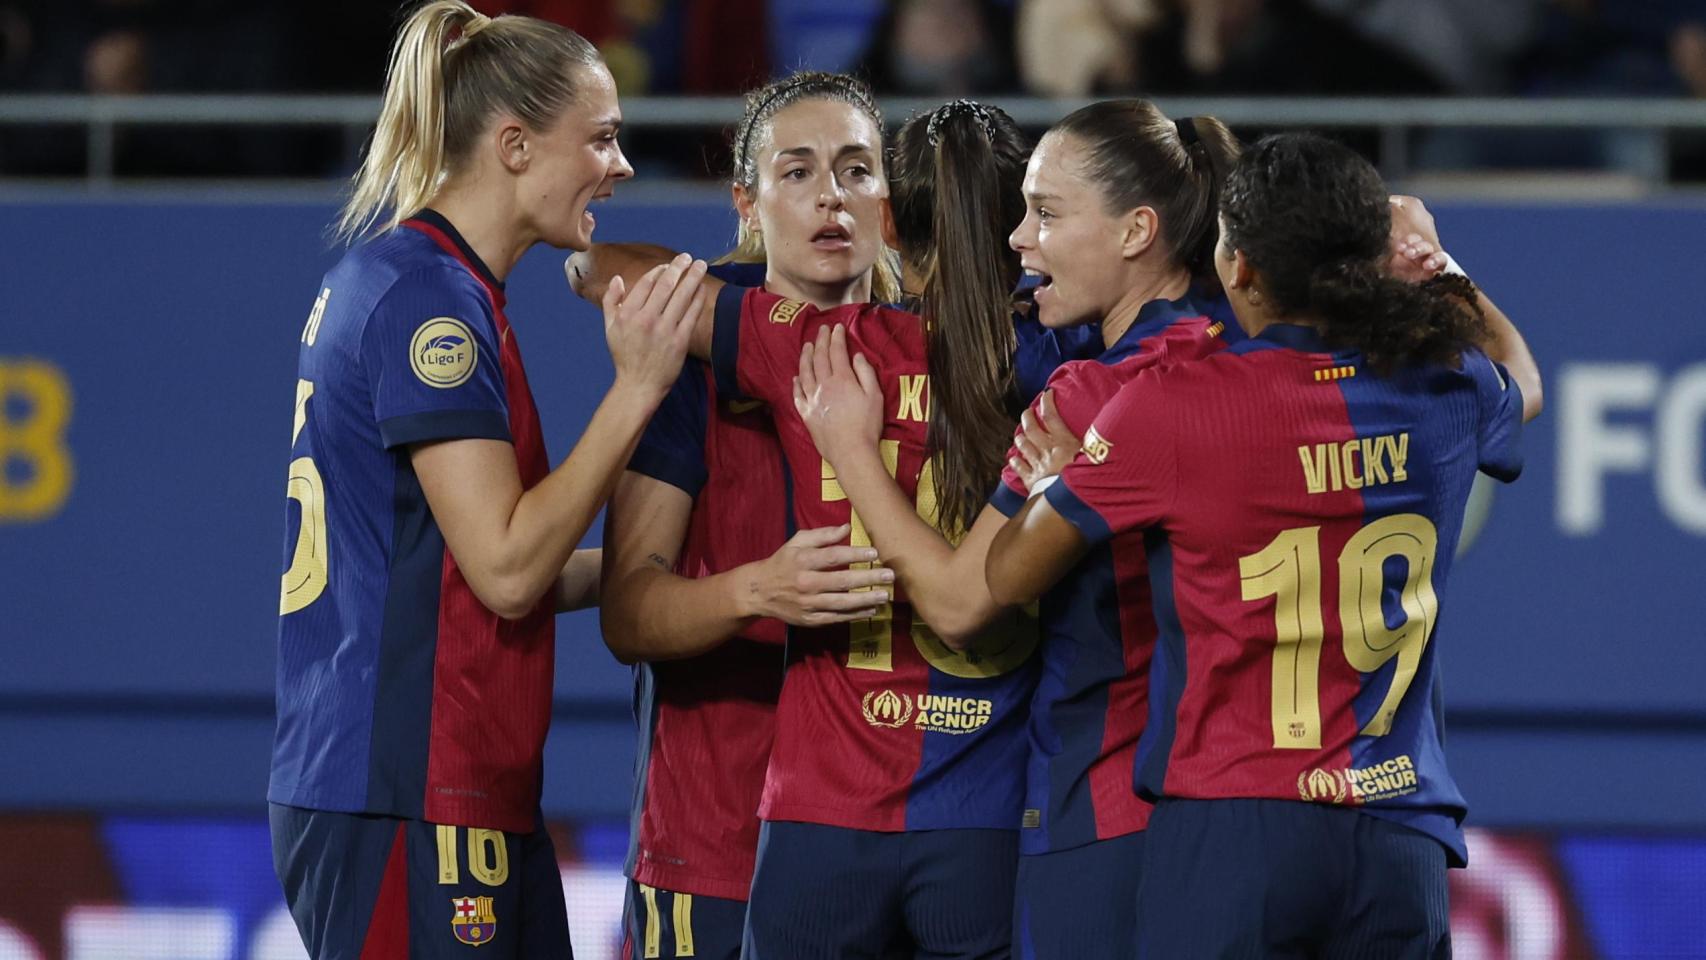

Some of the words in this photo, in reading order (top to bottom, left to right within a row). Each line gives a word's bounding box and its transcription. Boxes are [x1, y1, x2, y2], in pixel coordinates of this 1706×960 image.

[428, 354, 454, 365] Liga
[457, 353, 464, 363] F
[1298, 433, 1409, 494] VICKY
[1239, 513, 1438, 749] 19
[917, 694, 992, 714] UNHCR
[914, 711, 990, 728] ACNUR
[1344, 755, 1413, 783] UNHCR
[1351, 770, 1417, 797] ACNUR
